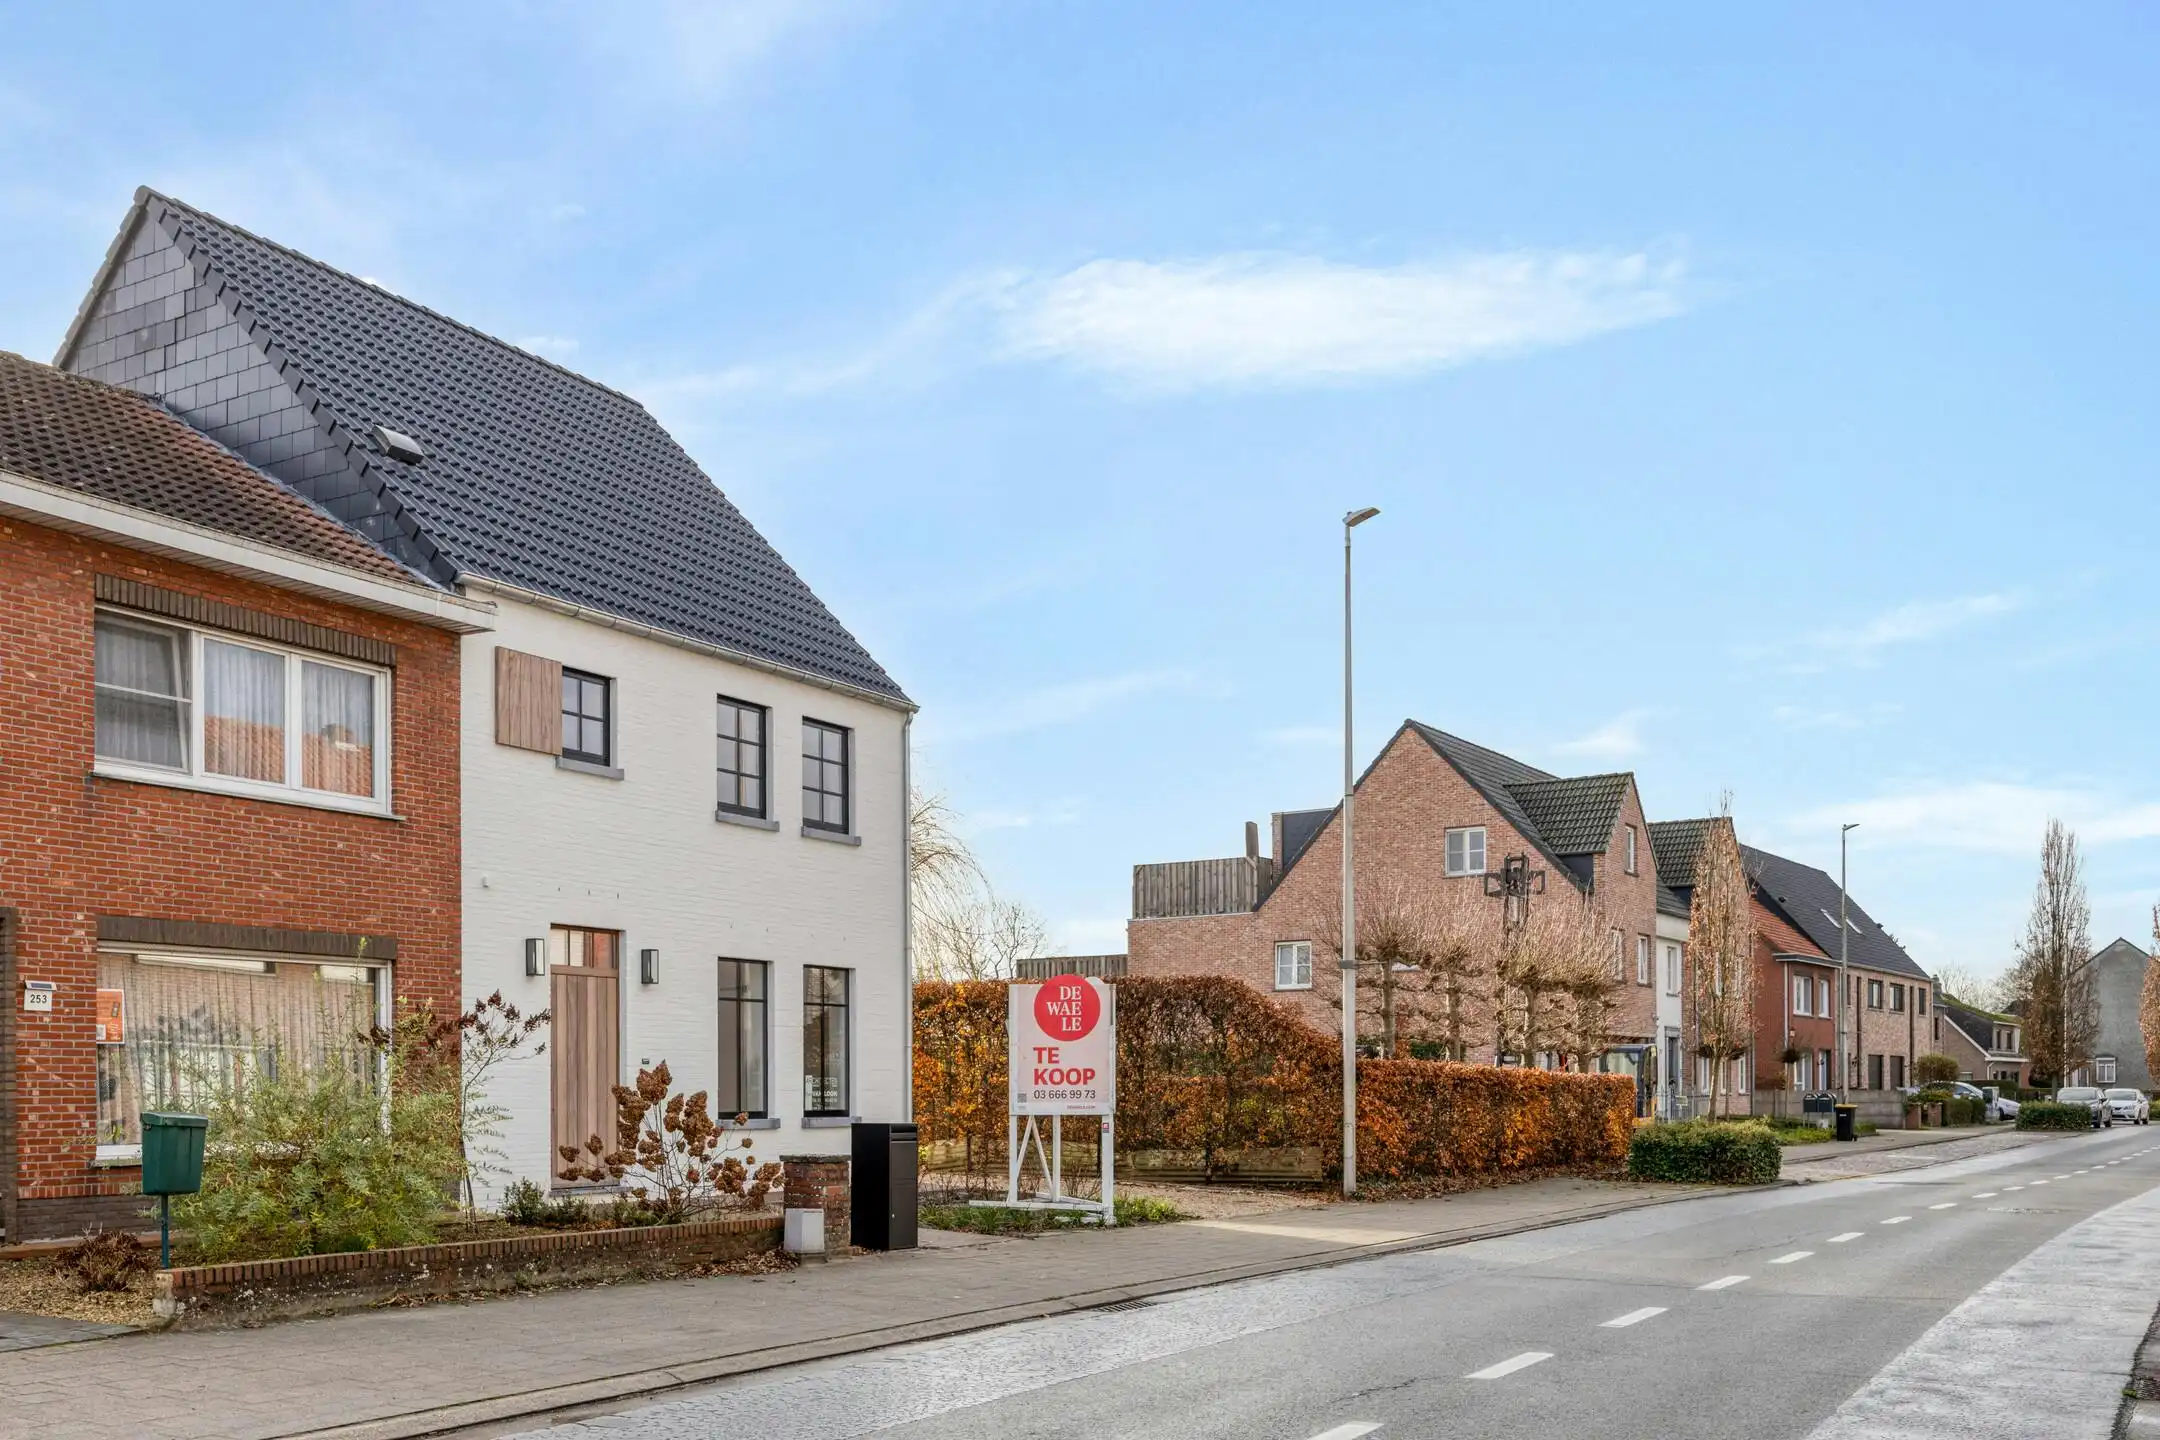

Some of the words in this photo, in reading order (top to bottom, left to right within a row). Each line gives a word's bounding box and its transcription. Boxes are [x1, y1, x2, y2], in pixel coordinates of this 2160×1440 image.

[30, 994, 47, 1003] 253
[1059, 985, 1082, 1000] DE
[1046, 1001, 1082, 1016] WAE
[1061, 1017, 1082, 1031] LE
[1033, 1047, 1060, 1064] TE
[1033, 1068, 1096, 1085] KOOP
[1033, 1090, 1046, 1099] 03
[1048, 1090, 1067, 1099] 666
[1069, 1090, 1082, 1099] 99
[1084, 1090, 1096, 1099] 73
